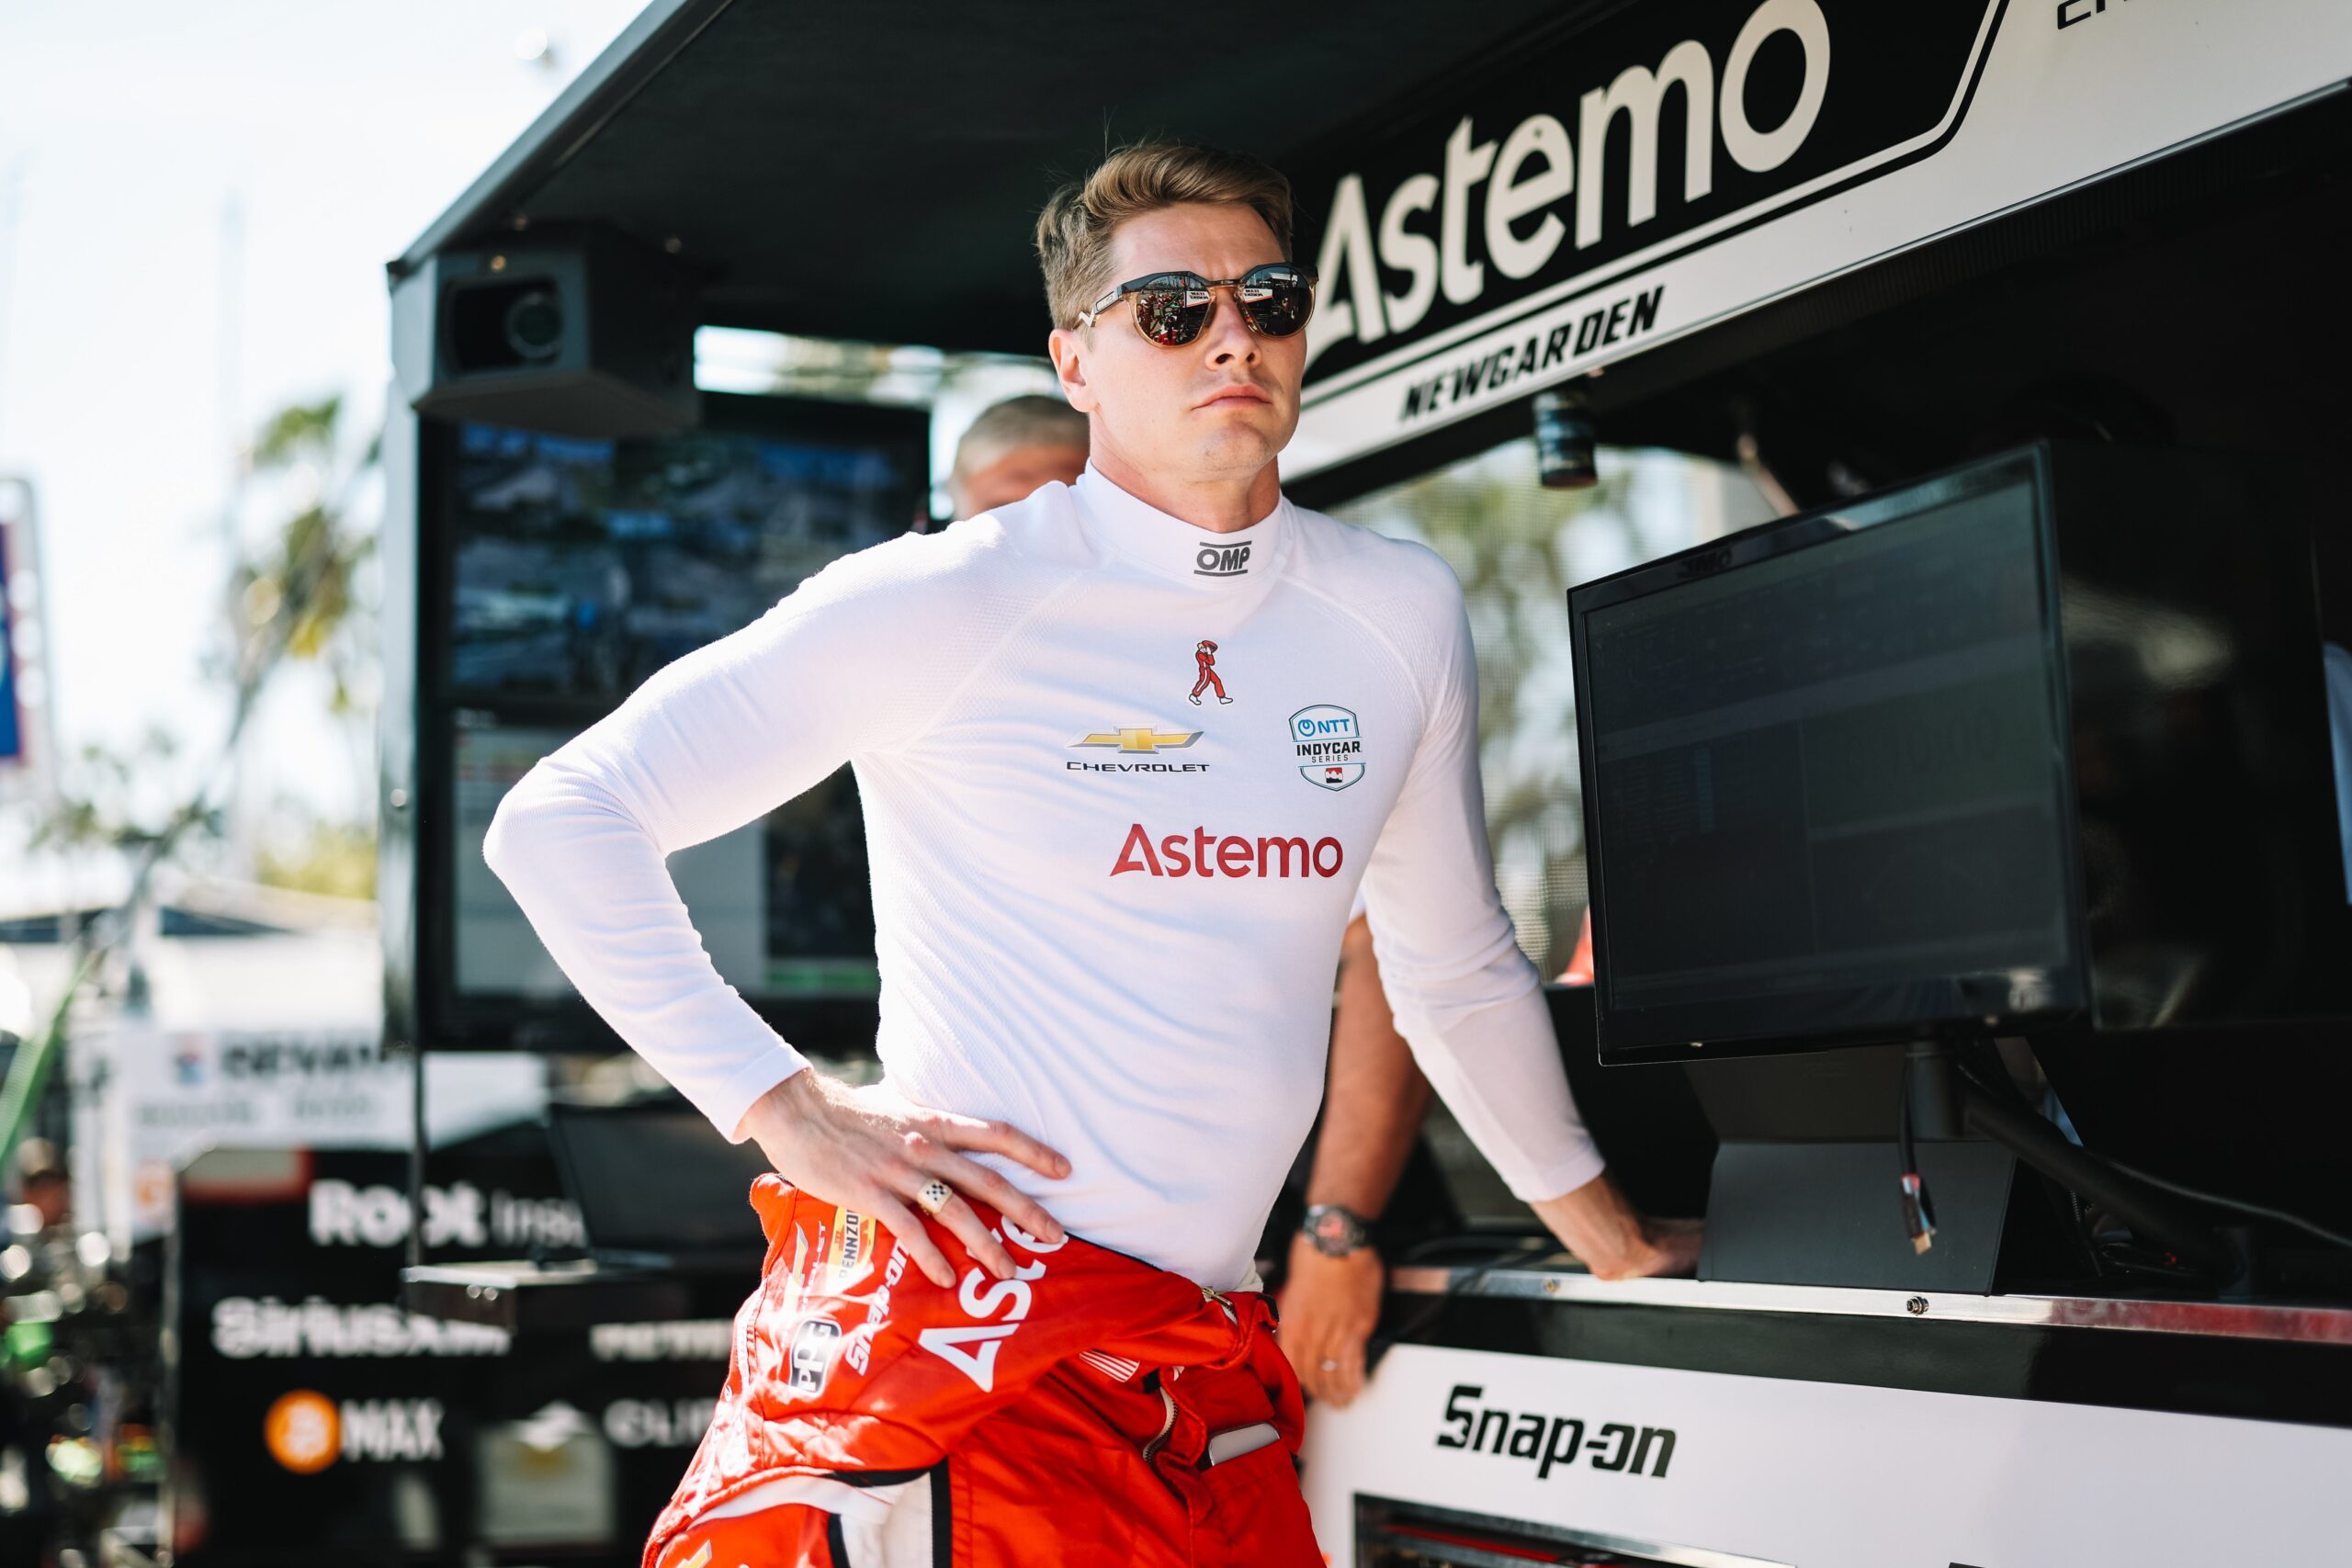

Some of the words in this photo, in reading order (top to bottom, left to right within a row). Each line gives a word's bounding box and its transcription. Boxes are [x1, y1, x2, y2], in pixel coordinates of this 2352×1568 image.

[1305, 0, 1831, 373] Astemo
[1398, 285, 1666, 423] NEWGARDEN
[1196, 547, 1251, 572] OMP
[1296, 740, 1361, 756] INDYCAR
[1317, 718, 1350, 734] NTT
[1066, 761, 1210, 773] CHEVROLET
[1311, 754, 1349, 763] SERIES
[1109, 823, 1344, 878] Astemo
[844, 1237, 910, 1376] Snap-on
[792, 1323, 832, 1392] PPG
[1436, 1383, 1677, 1479] Snap-on
